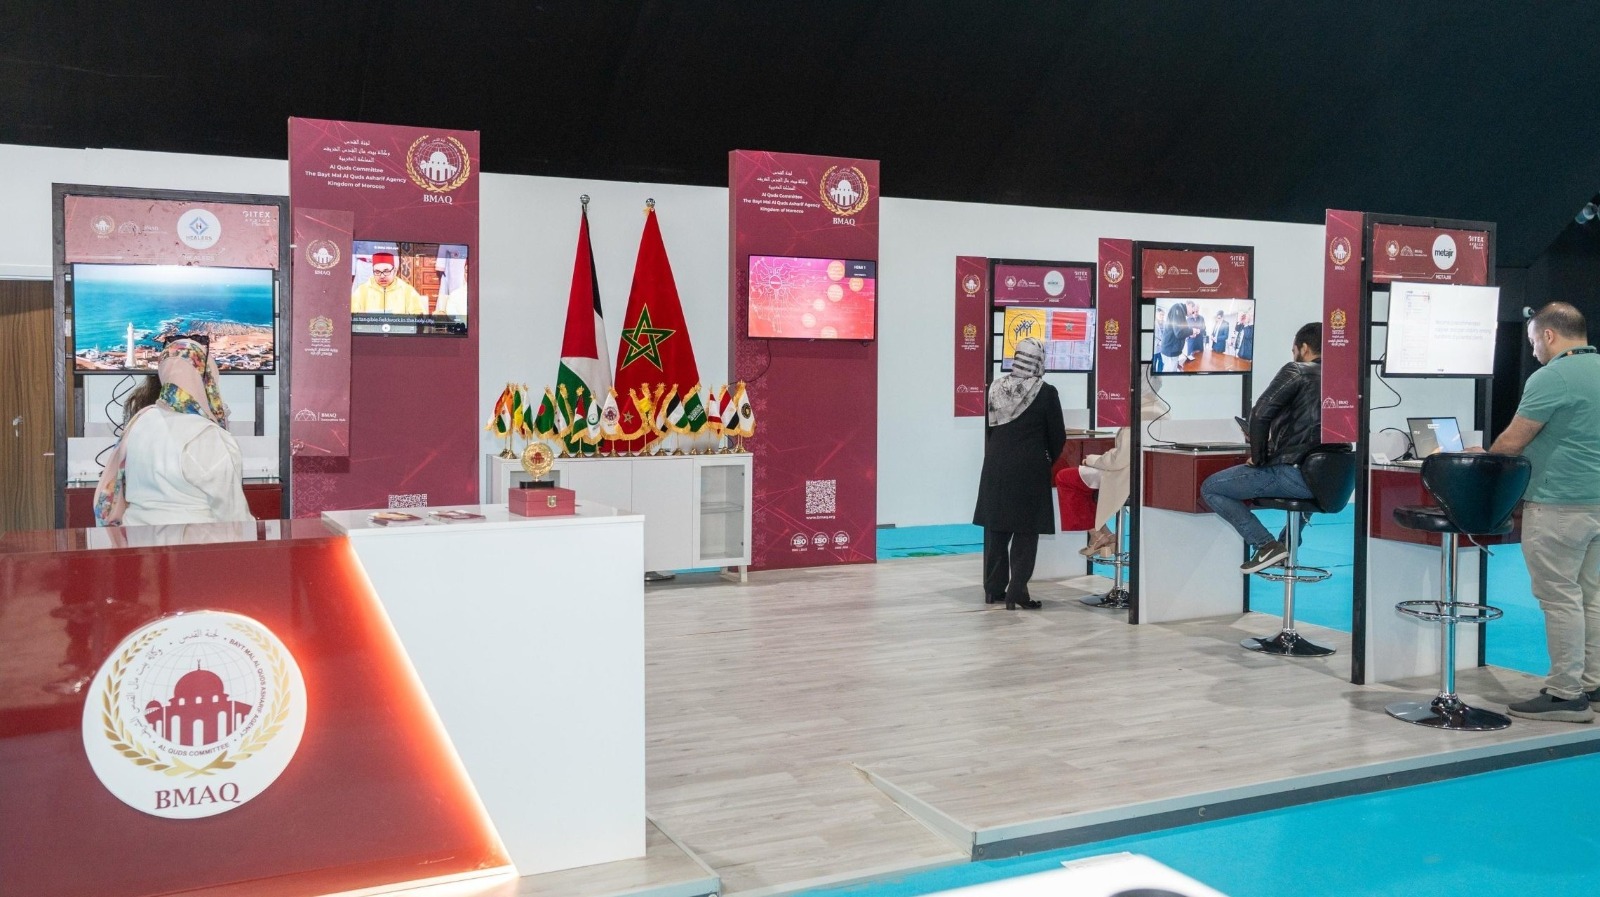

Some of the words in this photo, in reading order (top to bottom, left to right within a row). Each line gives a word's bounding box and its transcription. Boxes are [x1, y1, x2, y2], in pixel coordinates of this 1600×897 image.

[423, 194, 453, 205] BMAQ
[833, 217, 856, 226] BMAQ
[180, 628, 201, 644] القدس
[229, 639, 245, 651] BAYT
[244, 648, 255, 661] MAL
[253, 660, 260, 668] AL
[257, 668, 266, 686] QUDS
[257, 686, 266, 713] ASHARIF
[240, 714, 259, 736] AGENCY
[189, 742, 230, 756] COMMITTEE
[154, 782, 241, 810] BMAQ
